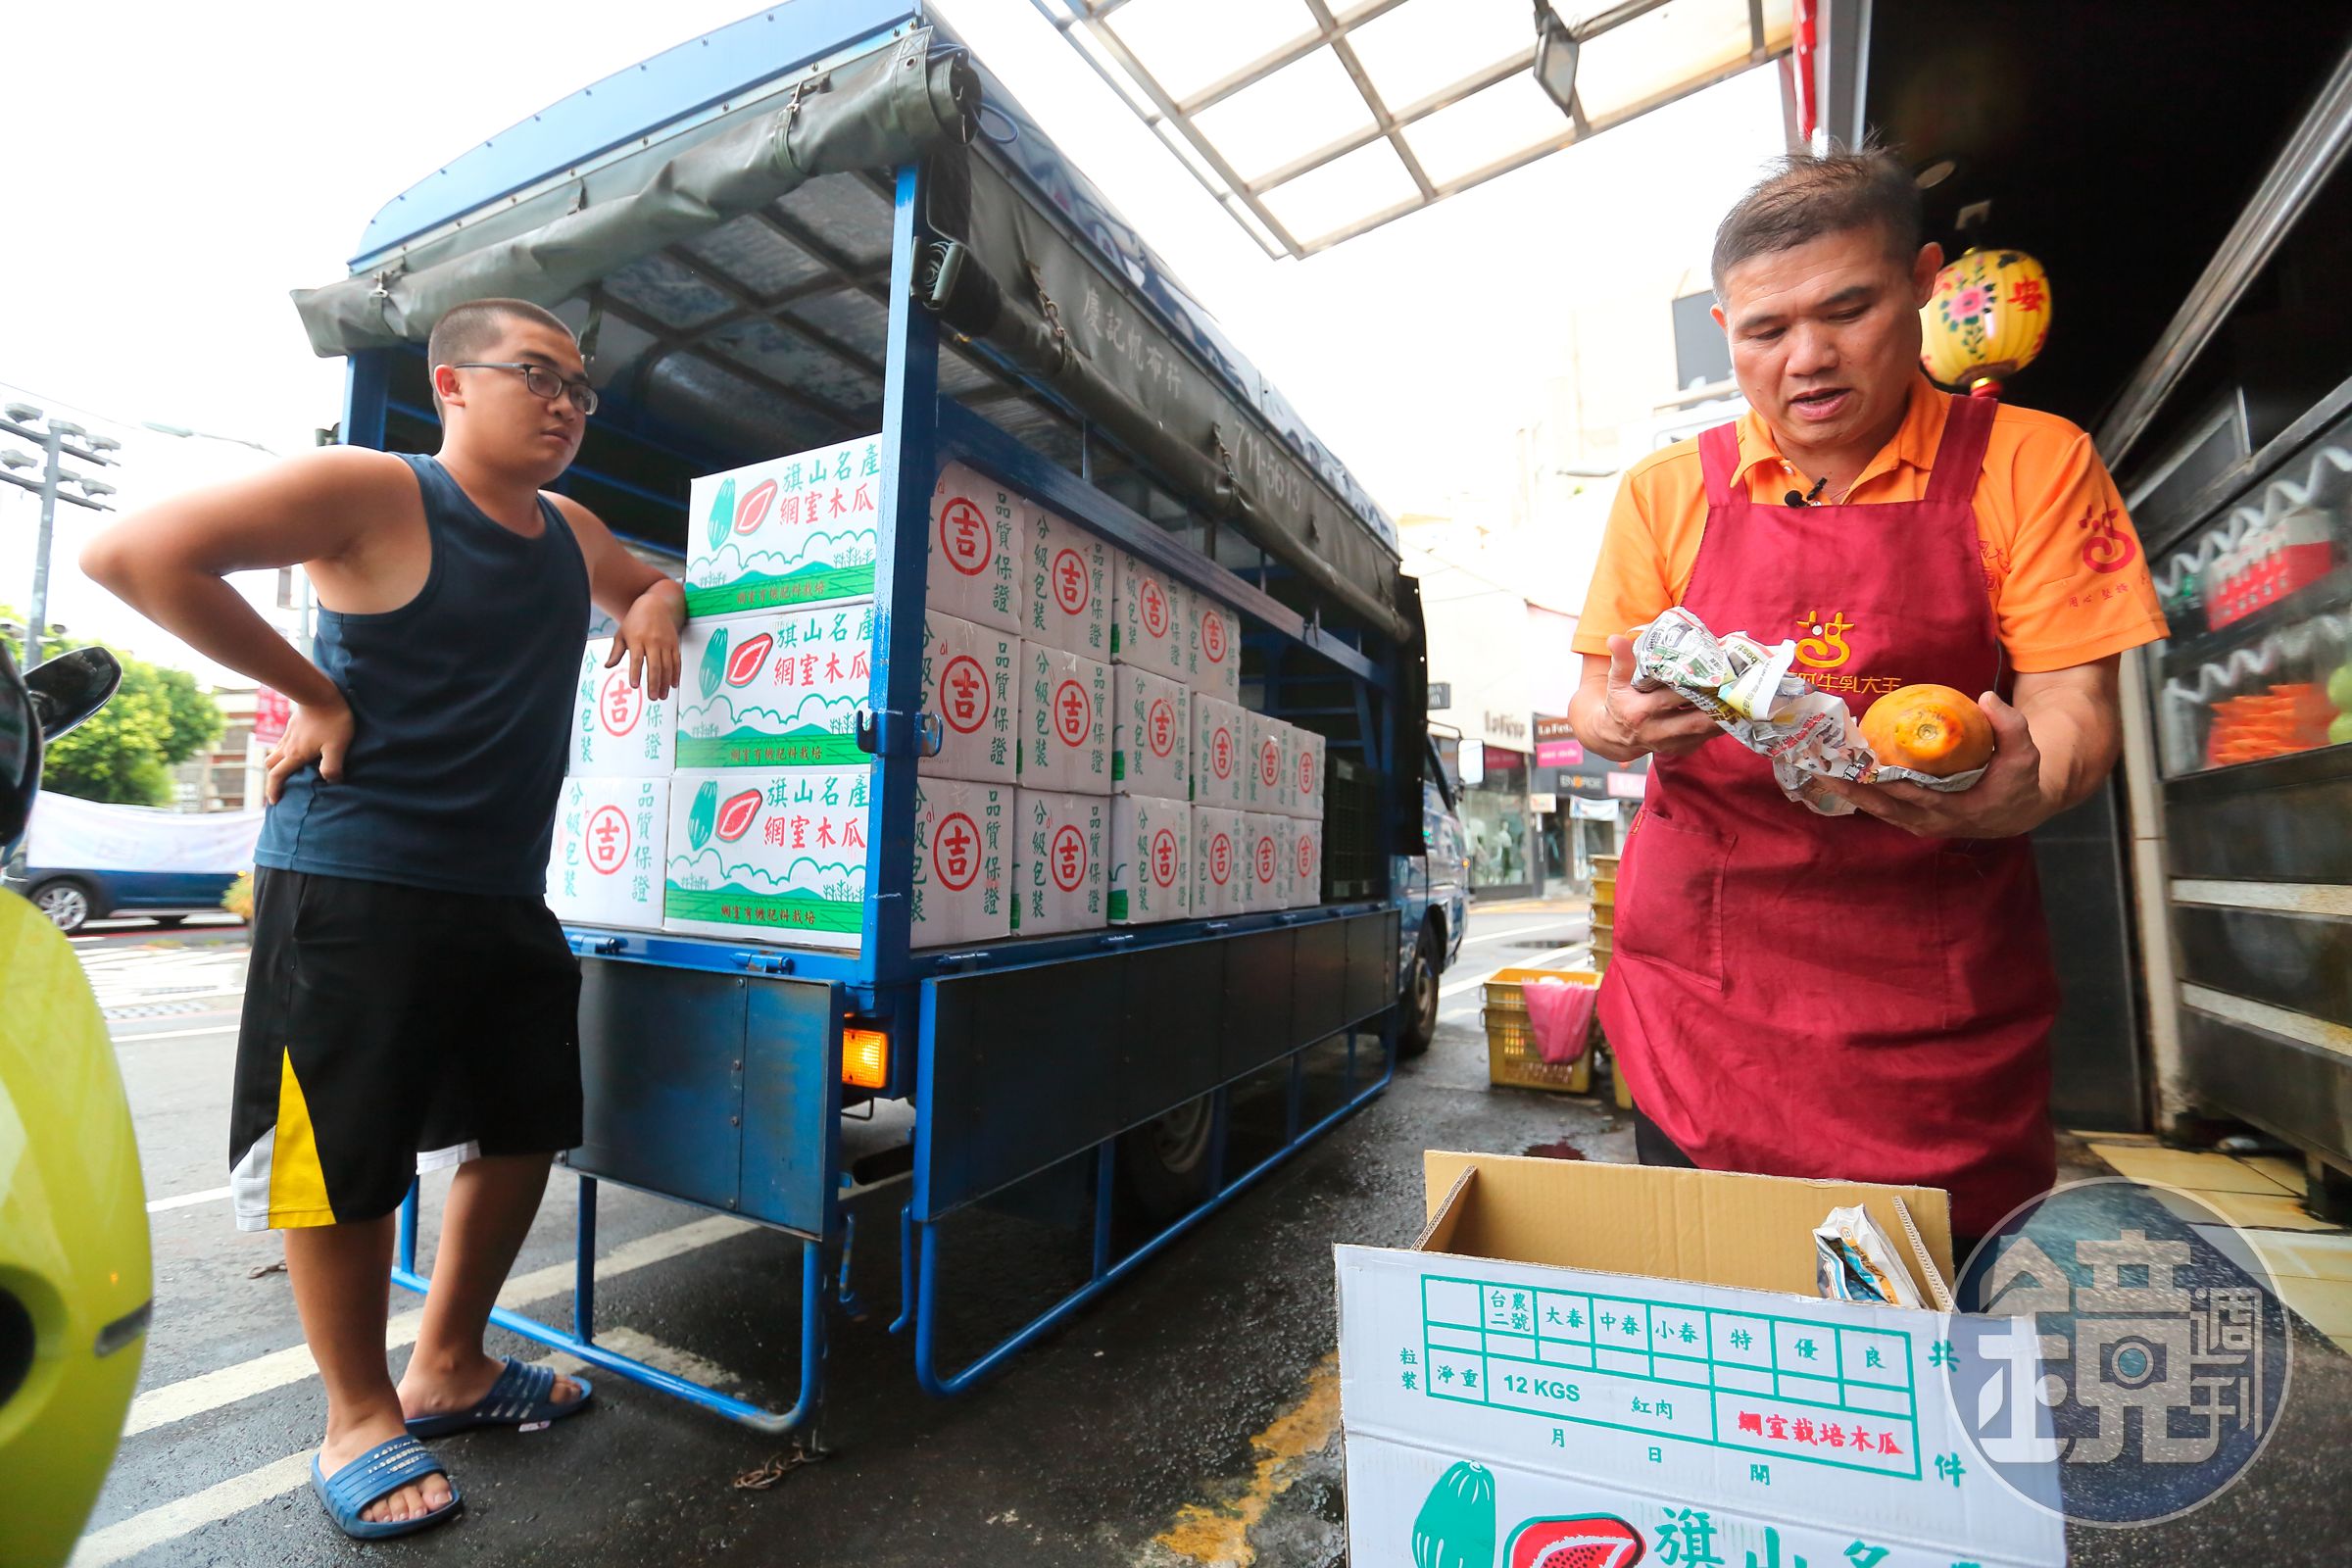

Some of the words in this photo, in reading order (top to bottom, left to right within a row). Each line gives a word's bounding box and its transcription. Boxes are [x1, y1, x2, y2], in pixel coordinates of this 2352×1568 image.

[783, 443, 880, 492] 旗山名產
[1235, 419, 1300, 512] 711-5613
[779, 482, 874, 525] 網室木瓜
[952, 508, 979, 558] 吉
[993, 492, 1011, 612] 品質保證
[1033, 514, 1050, 631] 分級包裝
[1060, 560, 1080, 603] 吉
[1089, 543, 1104, 648] 品質保證
[1147, 589, 1160, 627] 吉
[776, 608, 873, 649] 旗山名產
[1208, 619, 1219, 650] 吉
[772, 651, 870, 686] 網室木瓜
[580, 649, 597, 762] 分級包裝
[609, 680, 632, 723] 吉
[952, 667, 979, 718] 吉
[990, 642, 1009, 765] 品質保證
[1035, 650, 1051, 767] 分級包裝
[1062, 691, 1083, 734] 吉
[1091, 666, 1104, 773] 品質保證
[1155, 710, 1169, 745] 吉
[1217, 737, 1228, 768] 吉
[1265, 750, 1275, 777] 吉
[767, 774, 869, 808] 旗山名產
[564, 781, 584, 898] 分級包裝
[595, 816, 620, 861] 吉
[632, 782, 655, 903] 品質保證
[763, 815, 866, 849] 網室木瓜
[944, 825, 971, 876] 吉
[983, 790, 1001, 914] 品質保證
[1032, 800, 1048, 918] 分級包裝
[1059, 835, 1079, 878] 吉
[1088, 806, 1101, 913] 品質保證
[1138, 807, 1150, 910] 分級包裝
[1157, 839, 1172, 876] 吉
[1215, 840, 1227, 872] 吉
[1260, 844, 1271, 872] 吉
[1491, 1290, 1529, 1312] 台農
[1546, 1306, 1585, 1328] 大春
[1491, 1312, 1531, 1332] 二號
[1600, 1312, 1641, 1336] 中春
[1655, 1320, 1699, 1344] 小春
[1730, 1329, 1753, 1351] 特
[1794, 1338, 1819, 1360] 優
[1865, 1346, 1886, 1369] 良
[1928, 1339, 1961, 1373] 共
[1399, 1348, 1419, 1391] 粒裝
[1437, 1365, 1479, 1388] 淨重
[1504, 1374, 1528, 1394] 12
[1534, 1379, 1581, 1402] KGS
[1631, 1396, 1673, 1420] 紅肉
[1551, 1428, 1566, 1447] 月
[1648, 1446, 1662, 1463] 日
[1934, 1451, 1967, 1489] 件
